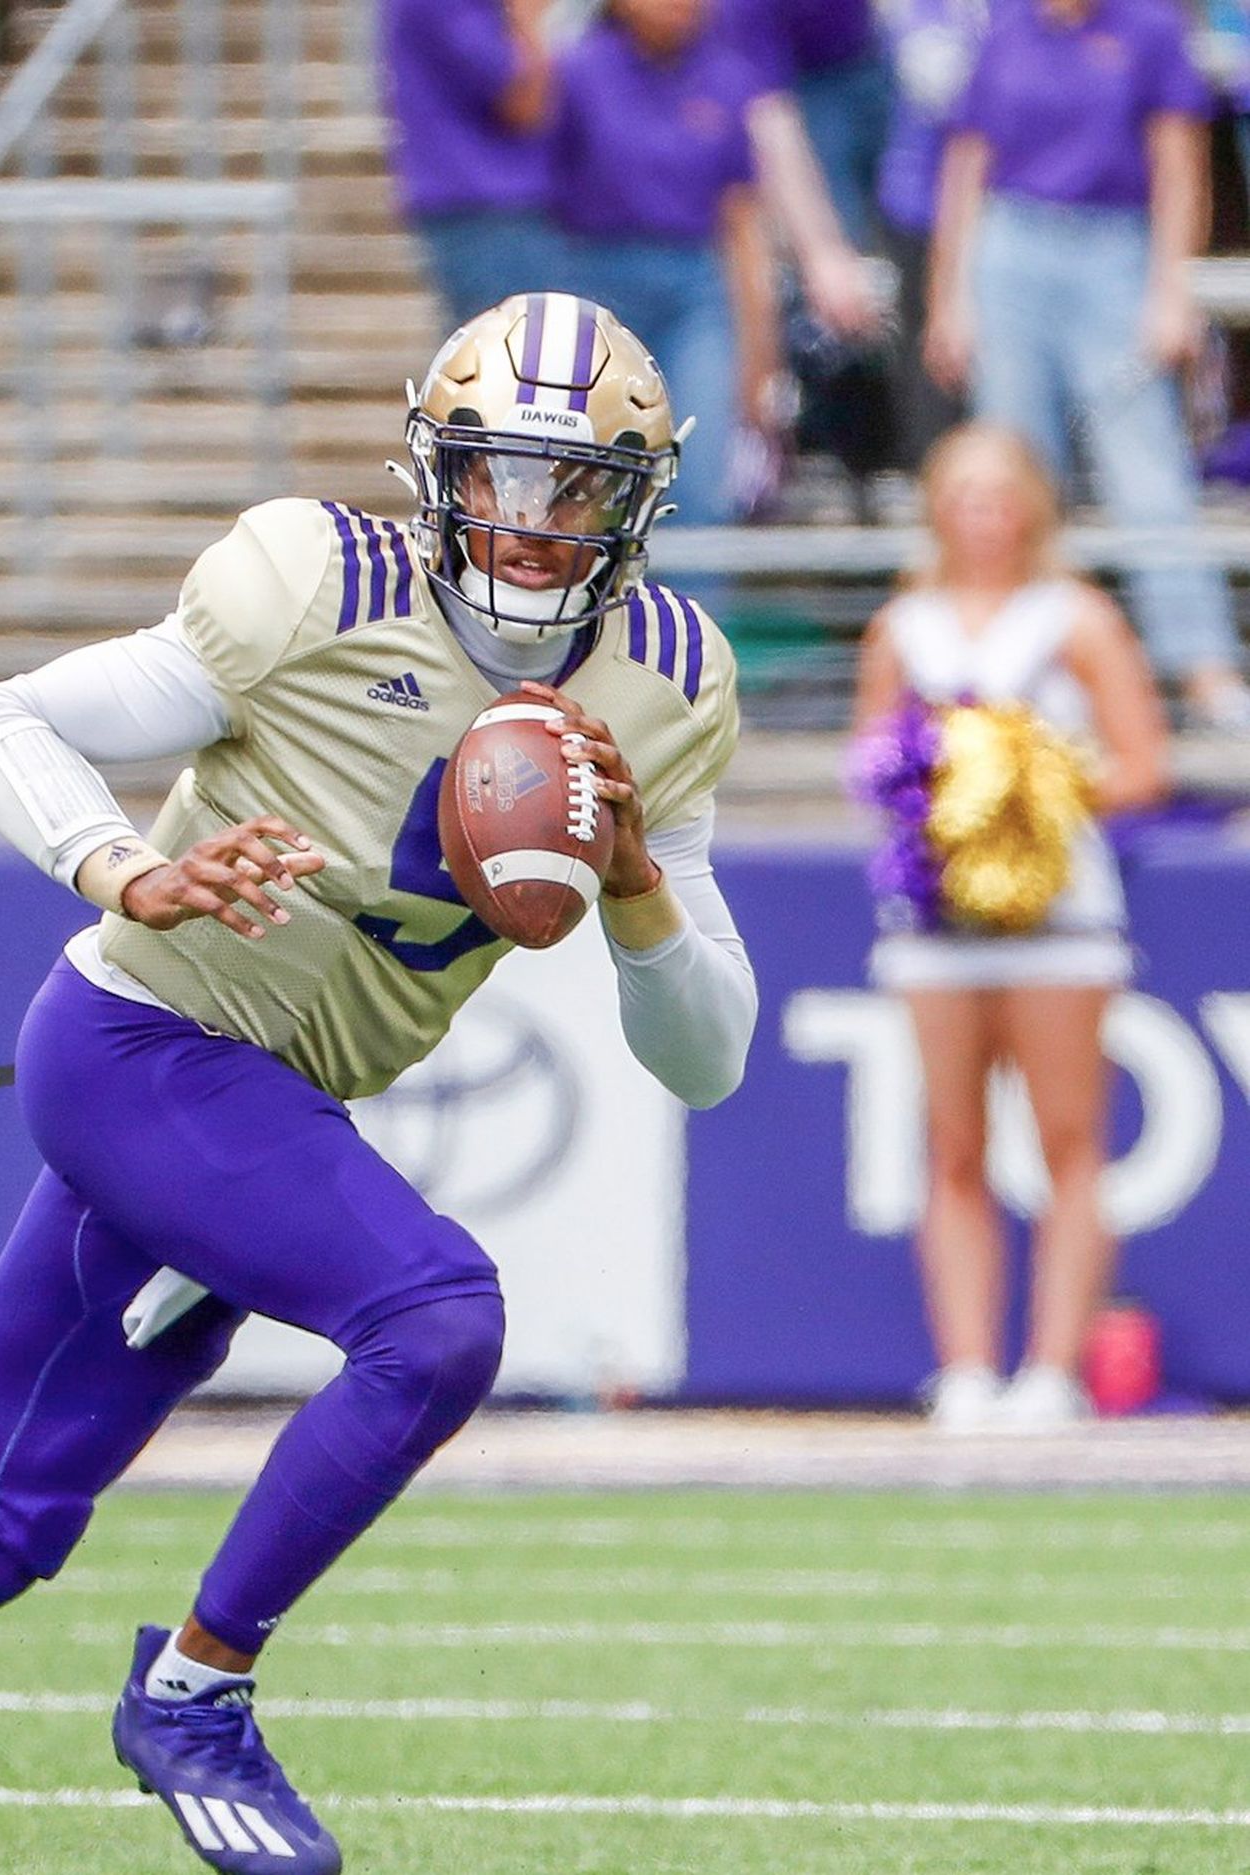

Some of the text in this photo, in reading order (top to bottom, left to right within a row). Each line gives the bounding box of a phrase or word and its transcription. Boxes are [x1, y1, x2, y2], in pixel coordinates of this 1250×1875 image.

[521, 410, 579, 428] DAWGS
[367, 687, 429, 711] adidas
[783, 985, 1250, 1238] TO
